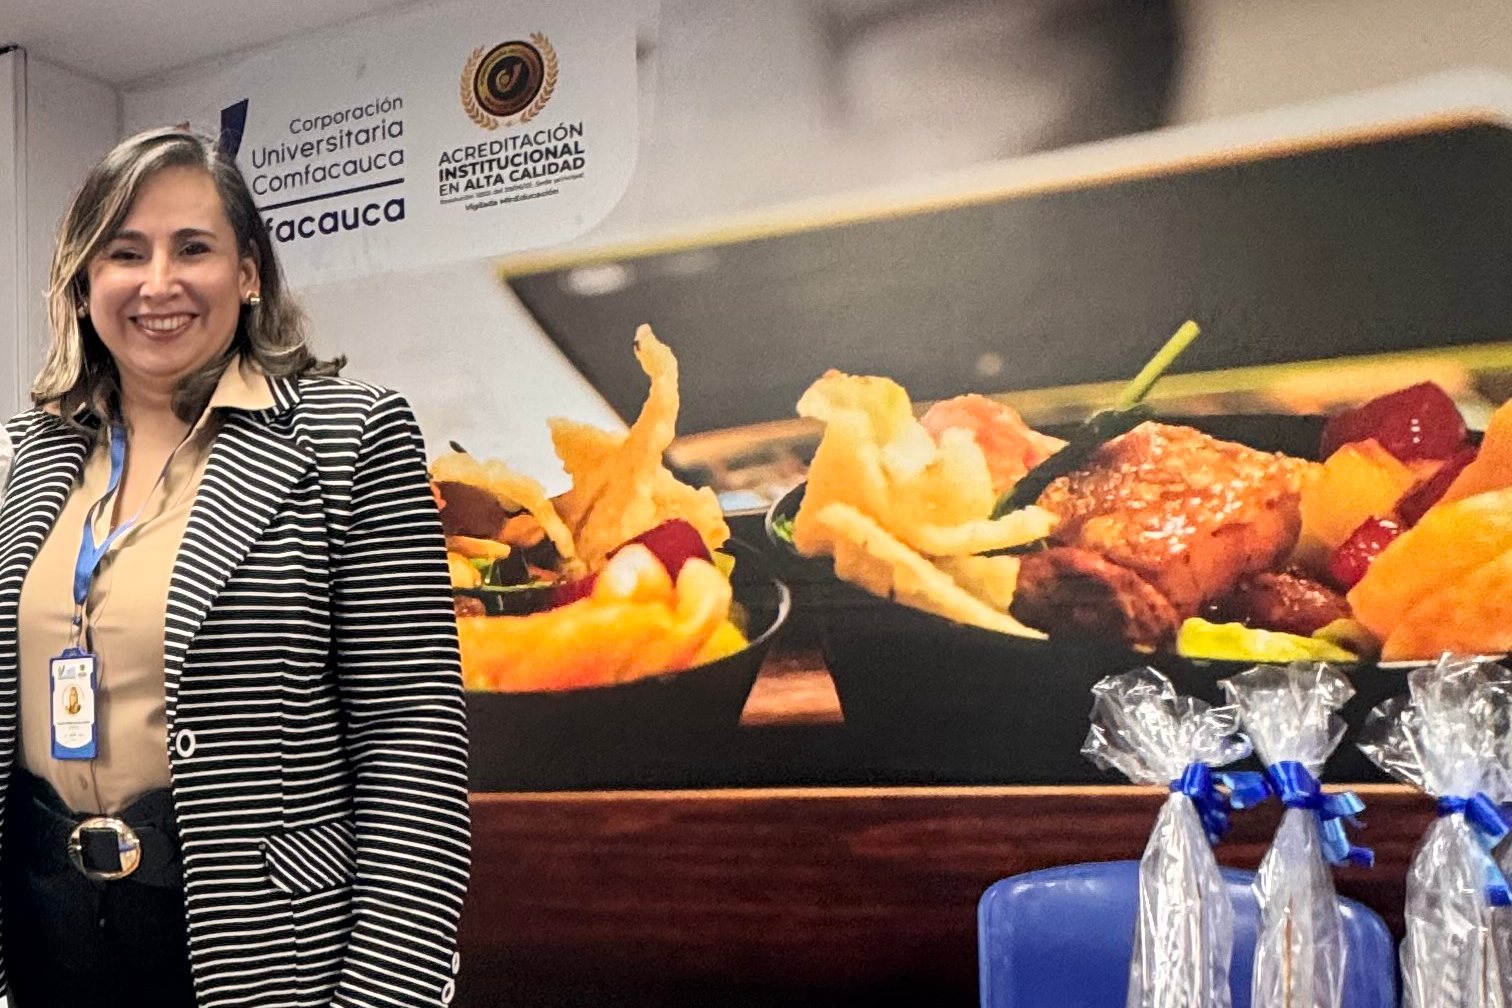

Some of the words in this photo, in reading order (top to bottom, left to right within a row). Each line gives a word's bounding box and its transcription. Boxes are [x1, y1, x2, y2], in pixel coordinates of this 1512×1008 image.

[289, 96, 403, 134] Corporación
[252, 118, 403, 169] Universitaria
[438, 122, 583, 166] ACREDITACIÓN
[439, 141, 585, 182] INSTITUCIONAL
[252, 149, 405, 195] Comfacauca
[439, 182, 459, 197] EN
[464, 173, 505, 192] ALTA
[509, 157, 585, 183] CALIDAD
